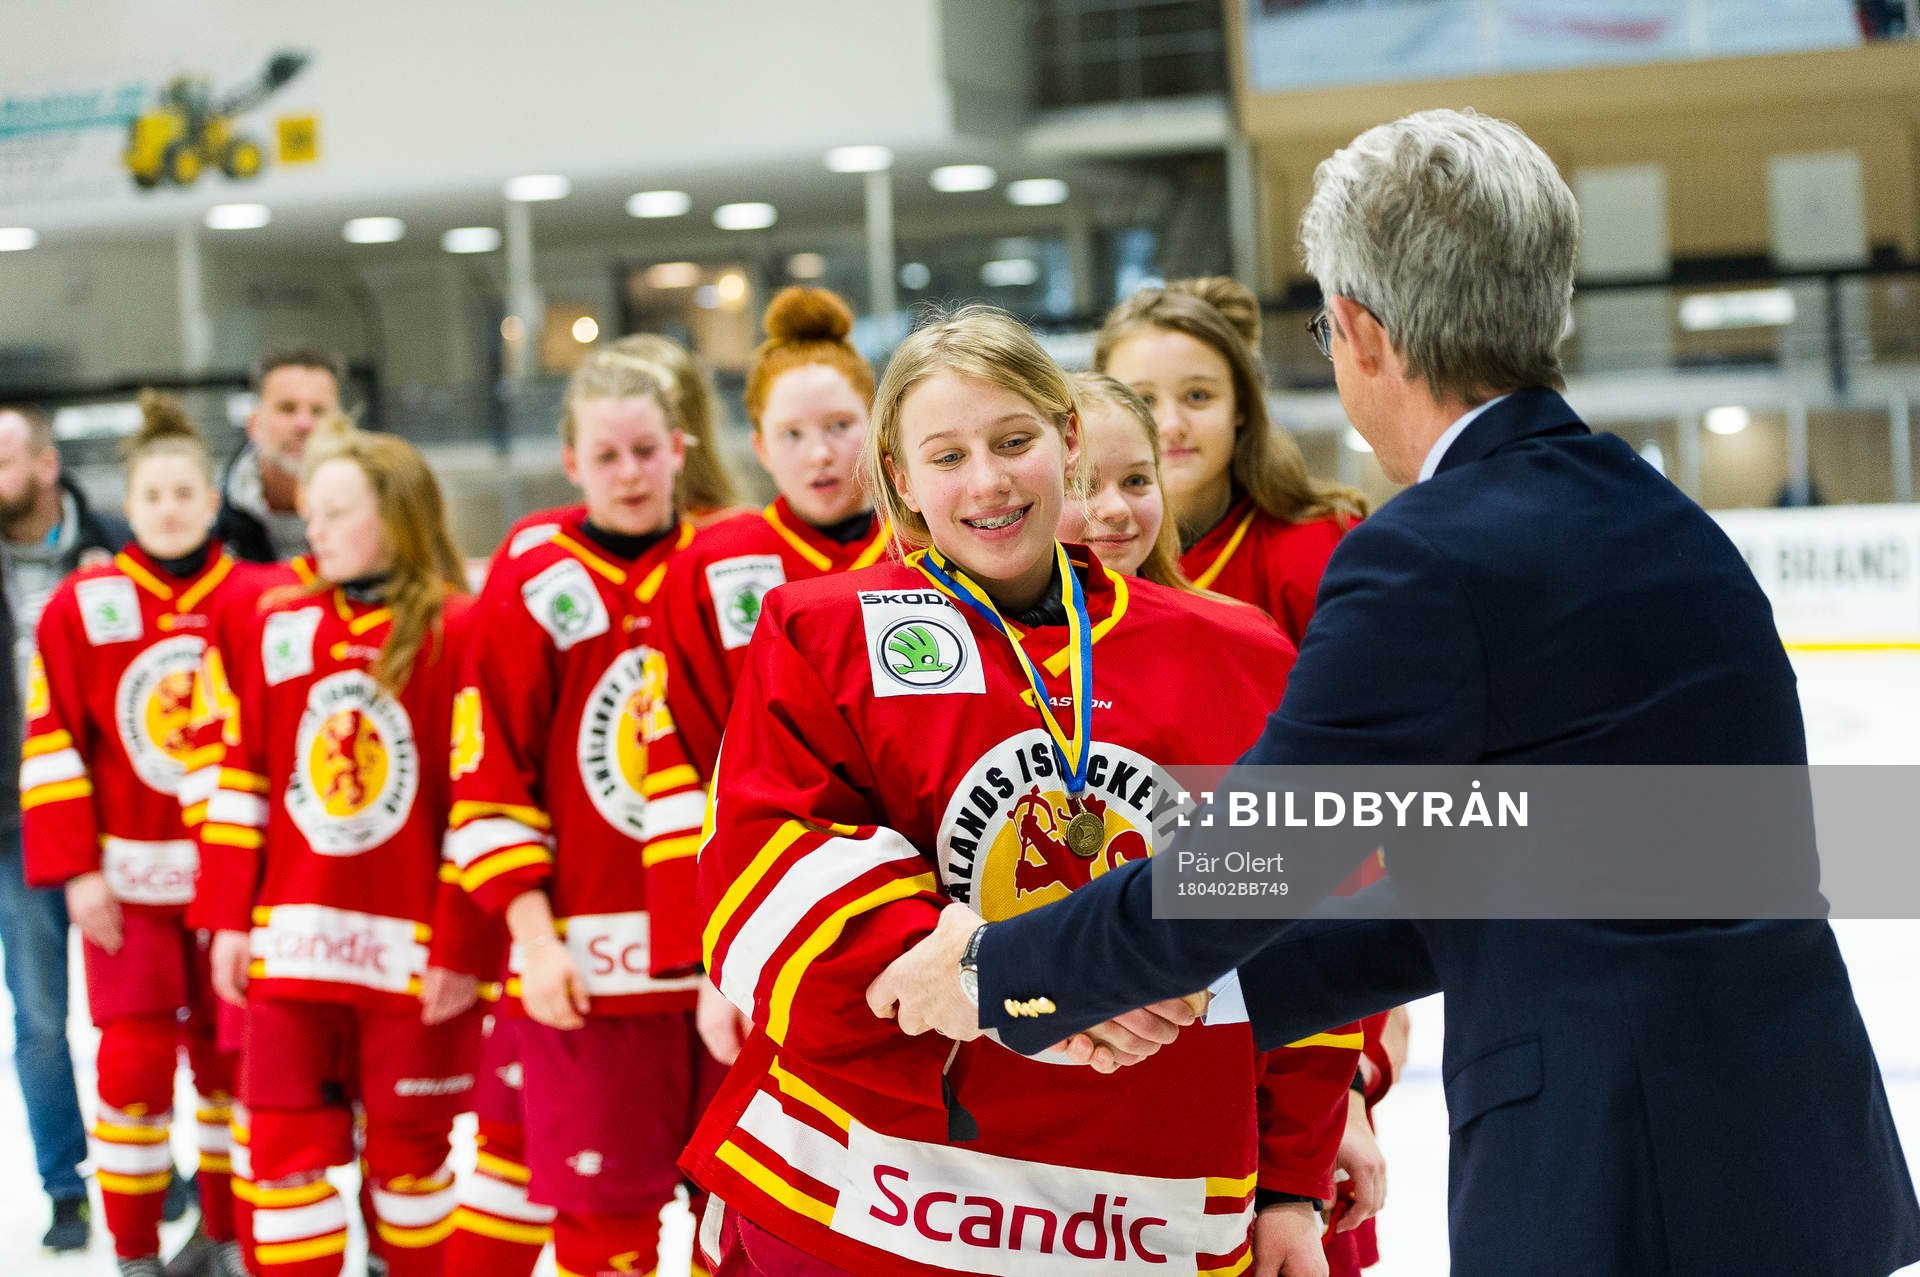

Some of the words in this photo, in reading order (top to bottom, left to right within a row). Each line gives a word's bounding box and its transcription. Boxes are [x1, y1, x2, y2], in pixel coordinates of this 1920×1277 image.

[944, 767, 1015, 904] ÅLANDS
[588, 935, 649, 975] Sc
[868, 1164, 1168, 1264] Scandic
